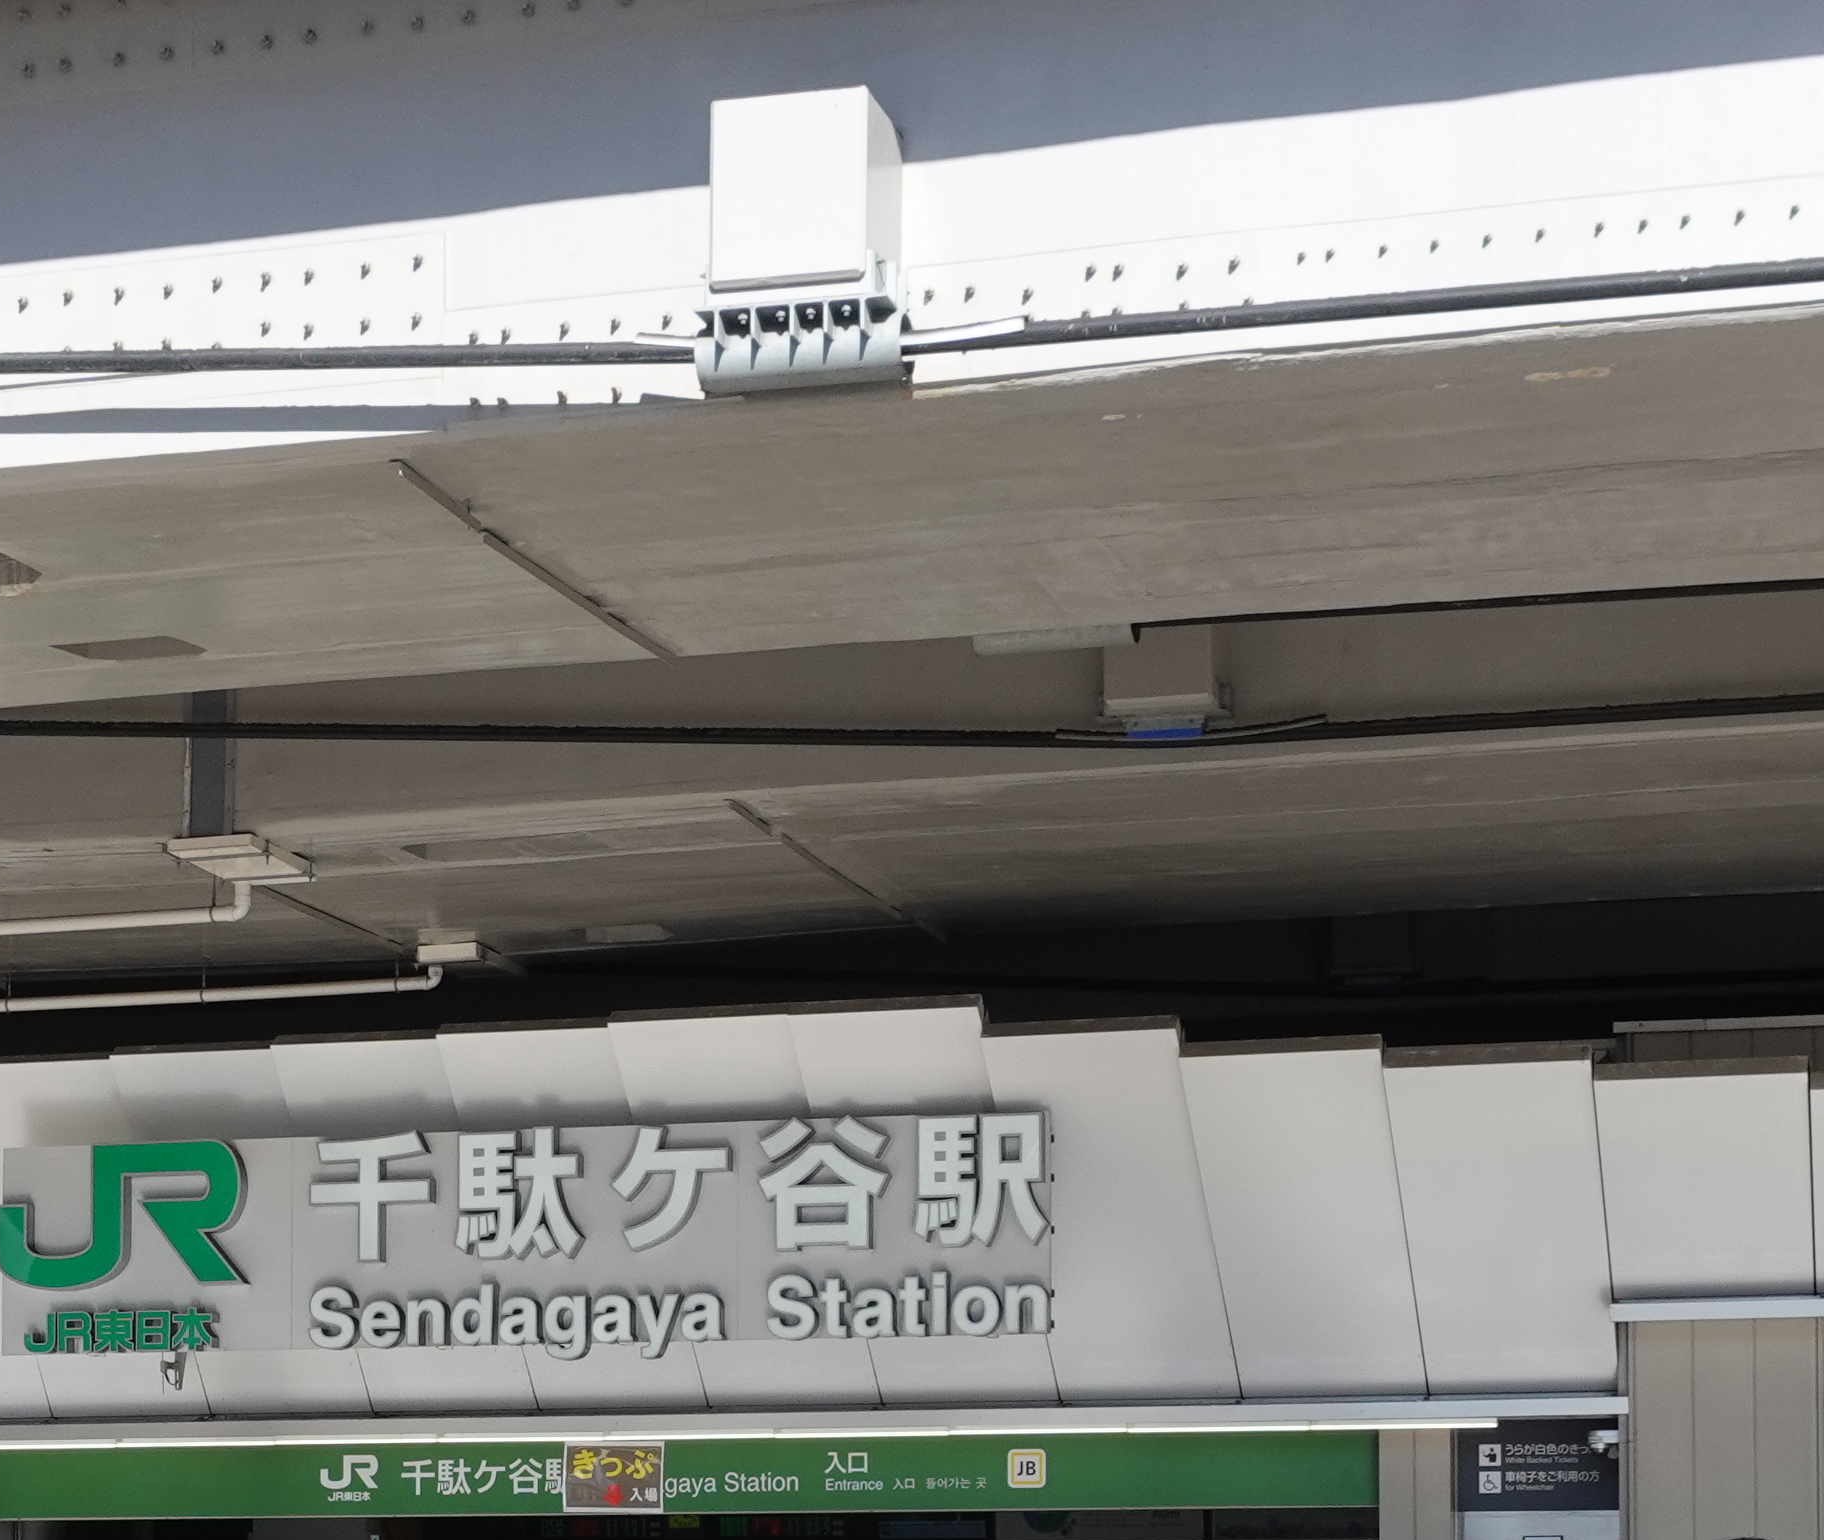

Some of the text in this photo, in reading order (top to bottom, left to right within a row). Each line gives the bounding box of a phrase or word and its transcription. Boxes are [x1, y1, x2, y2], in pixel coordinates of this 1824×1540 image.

[309, 1110, 1050, 1263] 千駄ケ谷駅
[308, 1270, 1050, 1361] Sendagaya Station
[24, 1307, 218, 1354] JR東日本
[320, 1454, 379, 1490] JR
[572, 1448, 655, 1479] きっぷ
[824, 1451, 869, 1474] 入口
[1016, 1460, 1037, 1477] JB
[723, 1471, 799, 1494] Station
[825, 1477, 884, 1492] Entrance
[1505, 1470, 1600, 1483] 車椅子をご利用の方
[327, 1491, 371, 1503] JR東日本
[629, 1487, 657, 1502] 入場
